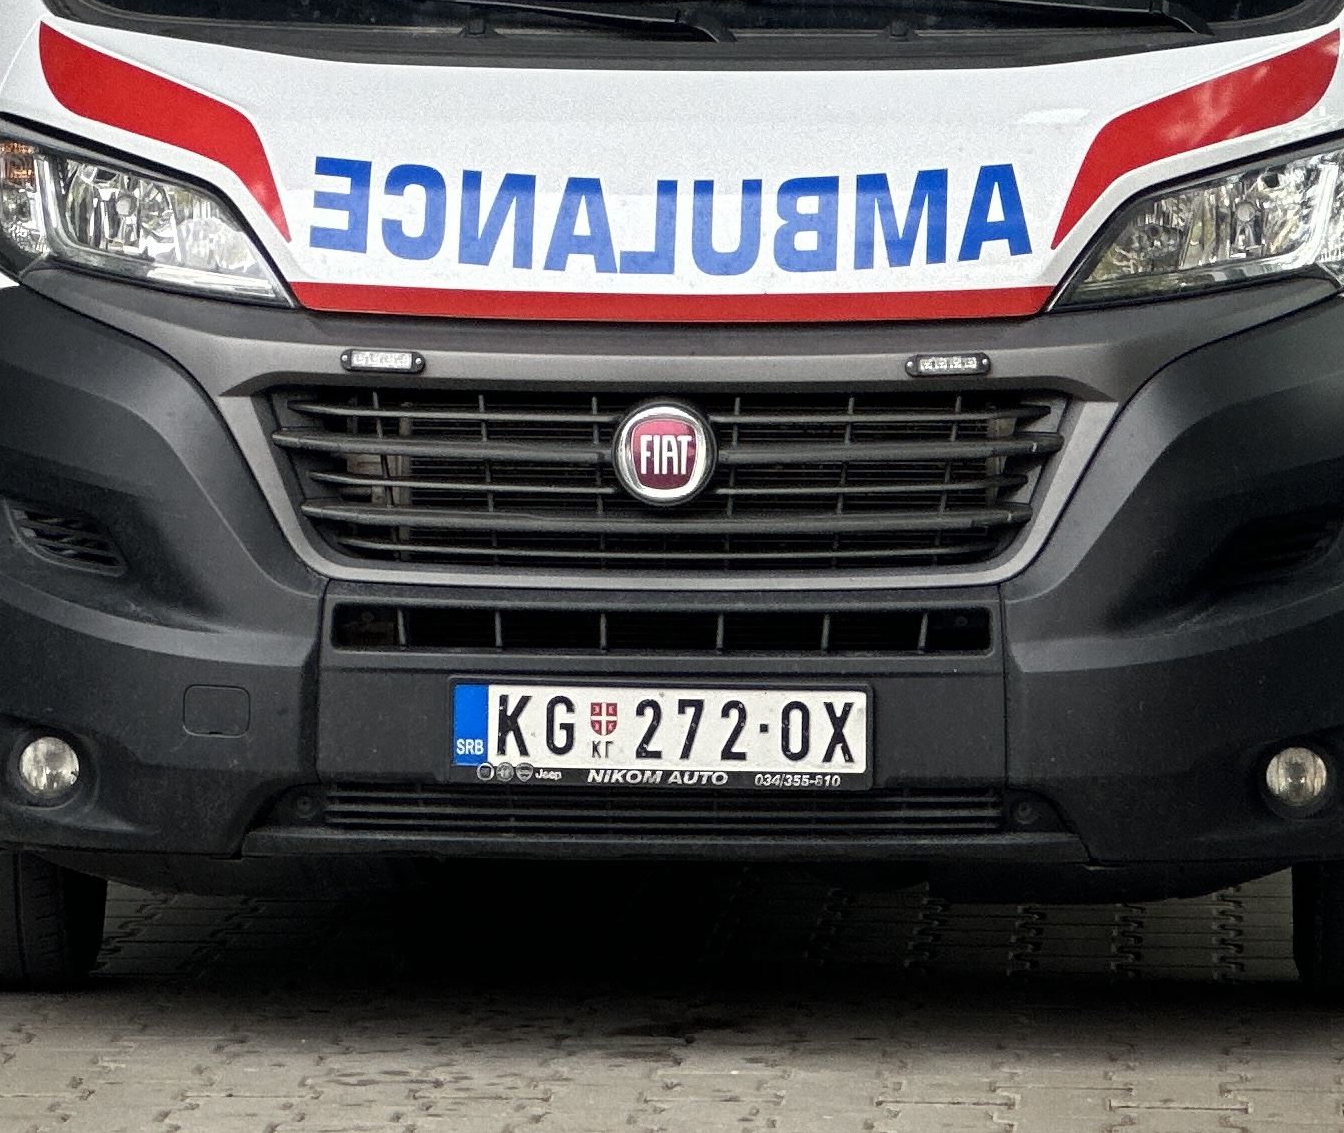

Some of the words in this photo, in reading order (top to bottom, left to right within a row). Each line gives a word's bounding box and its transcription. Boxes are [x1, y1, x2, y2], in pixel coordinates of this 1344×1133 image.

[640, 434, 693, 475] FIAT
[497, 694, 575, 757] KG
[456, 738, 485, 756] SRB
[587, 769, 663, 784] NIKOM
[668, 771, 729, 786] AUTO
